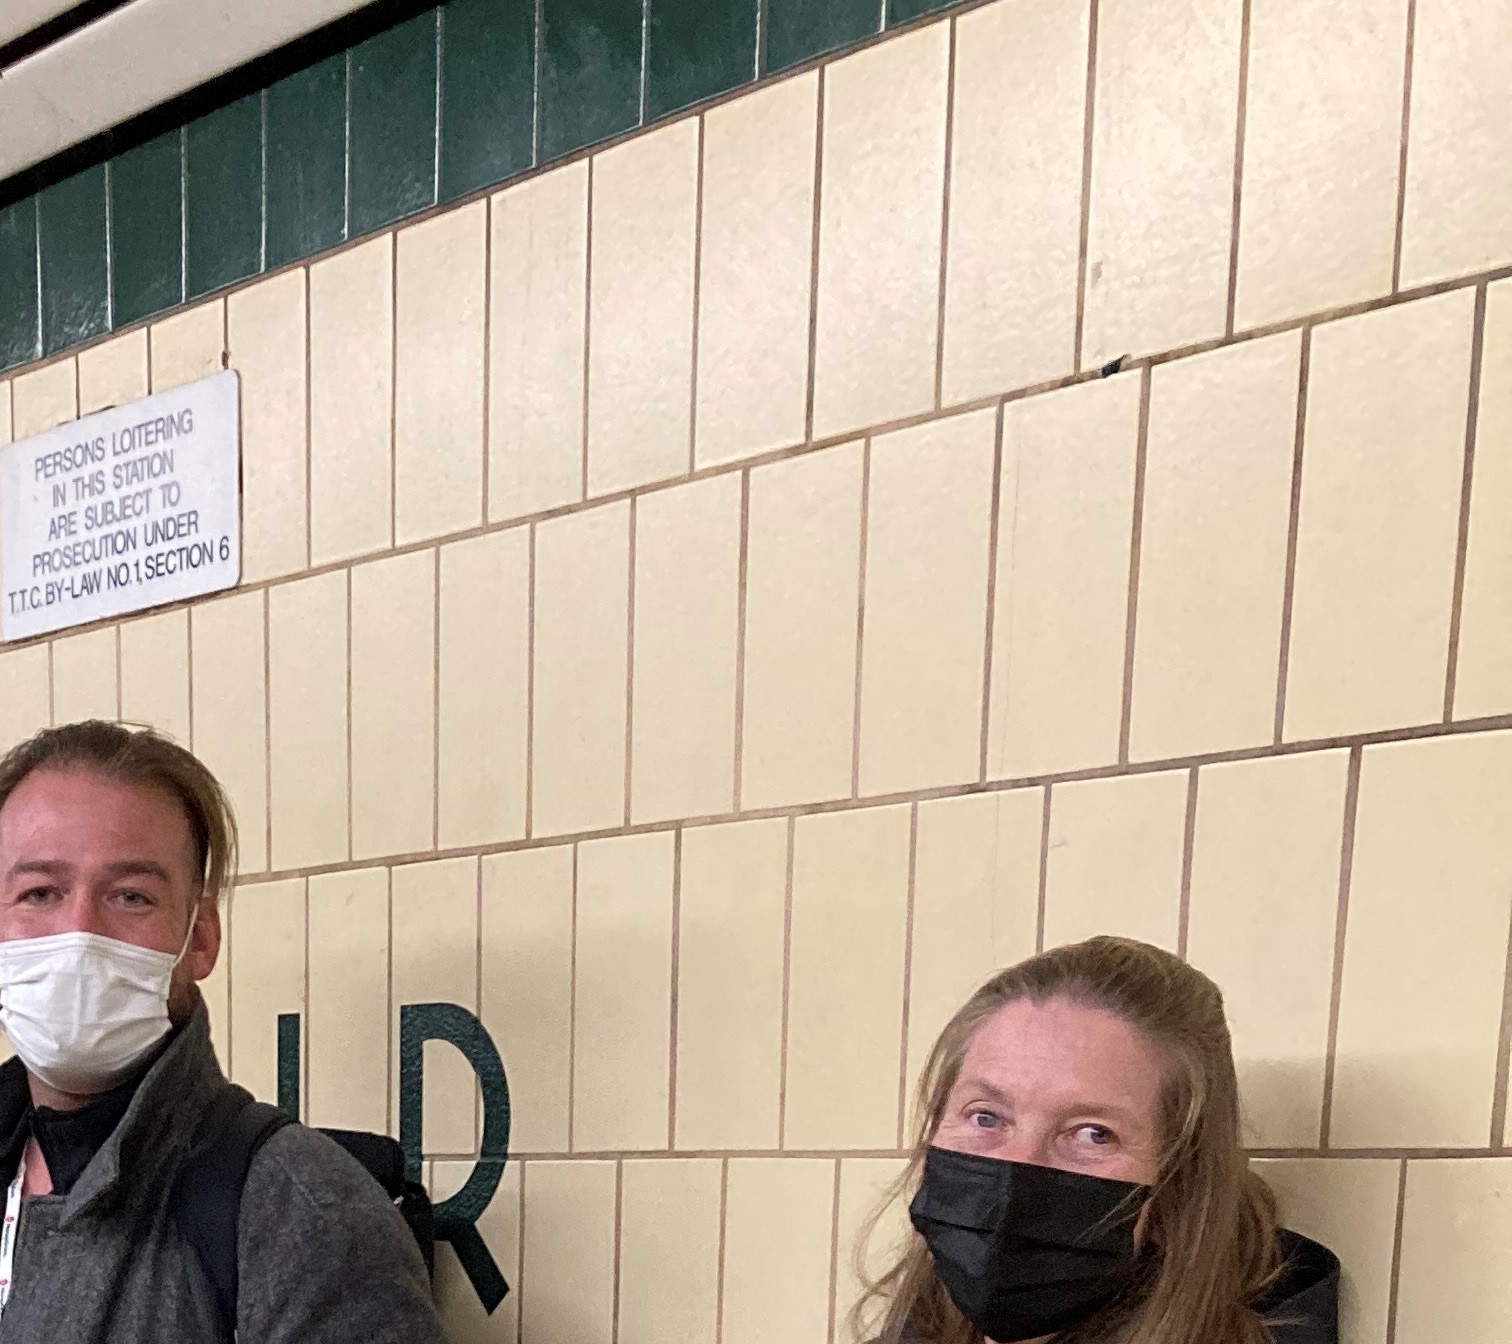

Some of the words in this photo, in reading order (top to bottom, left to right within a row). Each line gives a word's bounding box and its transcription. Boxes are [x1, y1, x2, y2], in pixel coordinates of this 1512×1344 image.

[35, 437, 105, 482] PERSONS
[112, 408, 194, 457] LOITERING
[52, 482, 67, 508] IN
[72, 469, 106, 499] THIS
[113, 448, 175, 490] STATION
[32, 525, 137, 578] PROSECUTION
[144, 509, 200, 547] UNDER
[48, 511, 77, 541] ARE
[84, 488, 153, 531] SUBJECT
[160, 480, 182, 508] TO
[46, 568, 103, 606] BY-LAW
[144, 538, 214, 581] SECTION
[219, 535, 230, 561] 6
